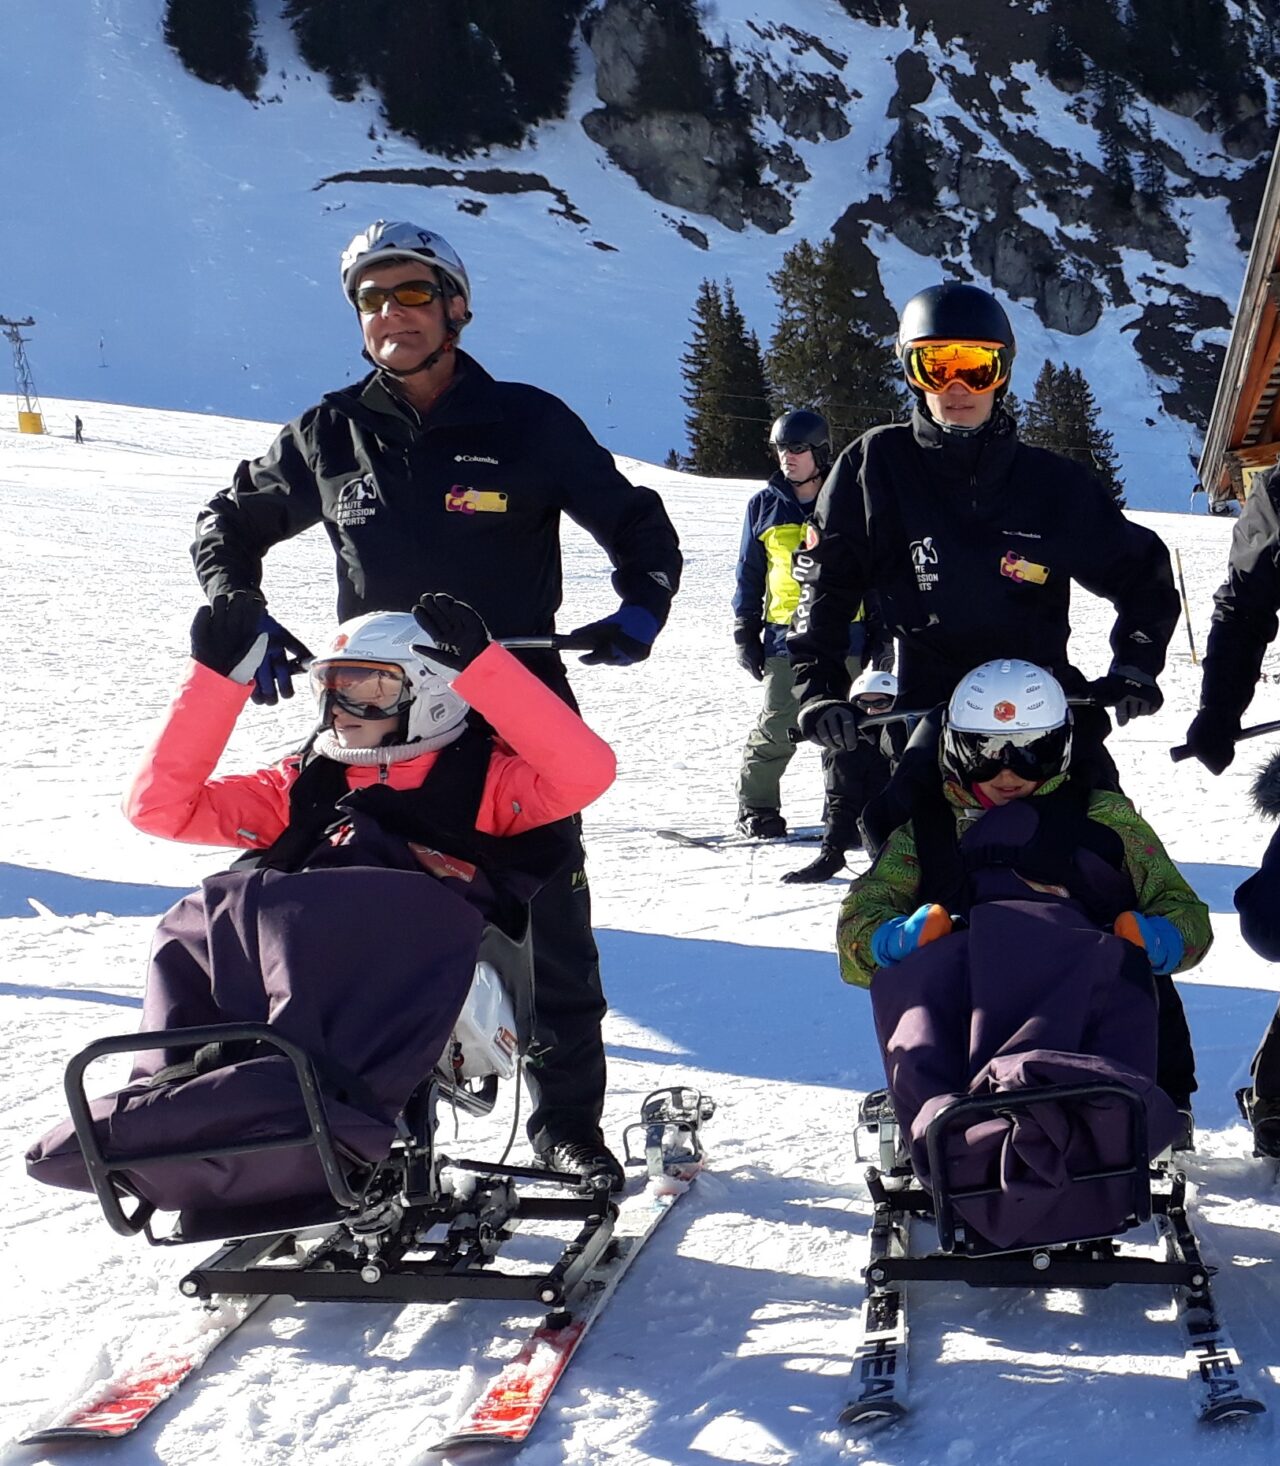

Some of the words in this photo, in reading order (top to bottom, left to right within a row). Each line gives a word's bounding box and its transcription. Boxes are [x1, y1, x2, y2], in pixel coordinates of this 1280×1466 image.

[462, 454, 499, 465] Columbia
[858, 1336, 897, 1402] HEA
[1193, 1339, 1243, 1404] HEA
